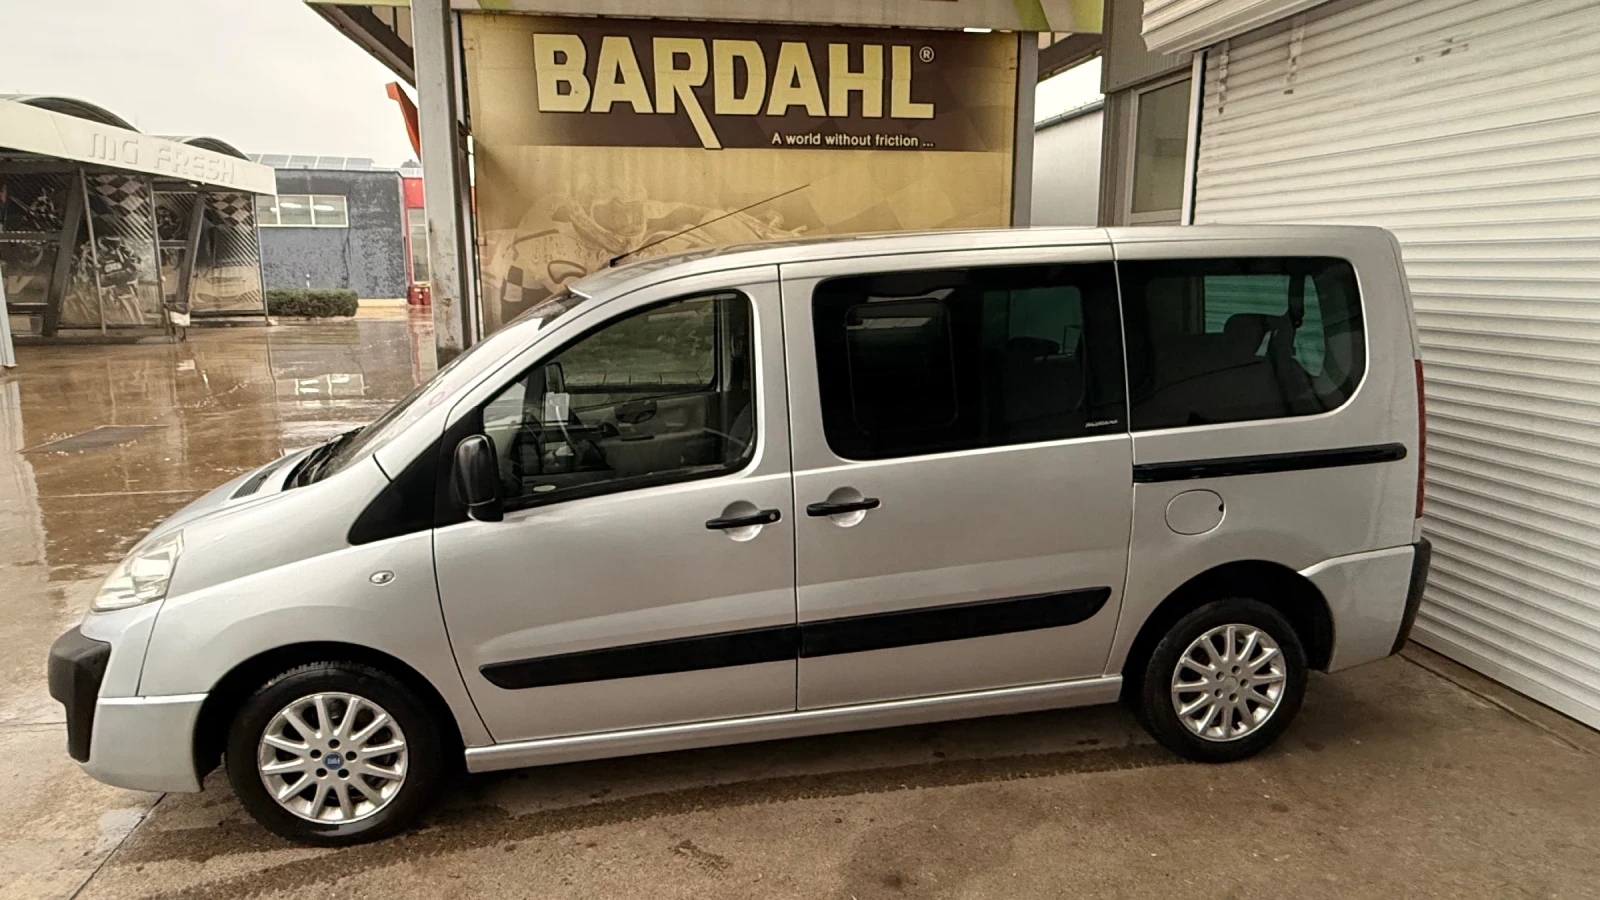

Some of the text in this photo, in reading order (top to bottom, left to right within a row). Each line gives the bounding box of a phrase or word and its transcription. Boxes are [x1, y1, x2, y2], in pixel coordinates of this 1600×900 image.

[771, 132, 782, 145] A
[786, 132, 821, 145] world
[825, 133, 871, 146] without
[875, 134, 918, 147] friction
[153, 142, 235, 185] FRESH
